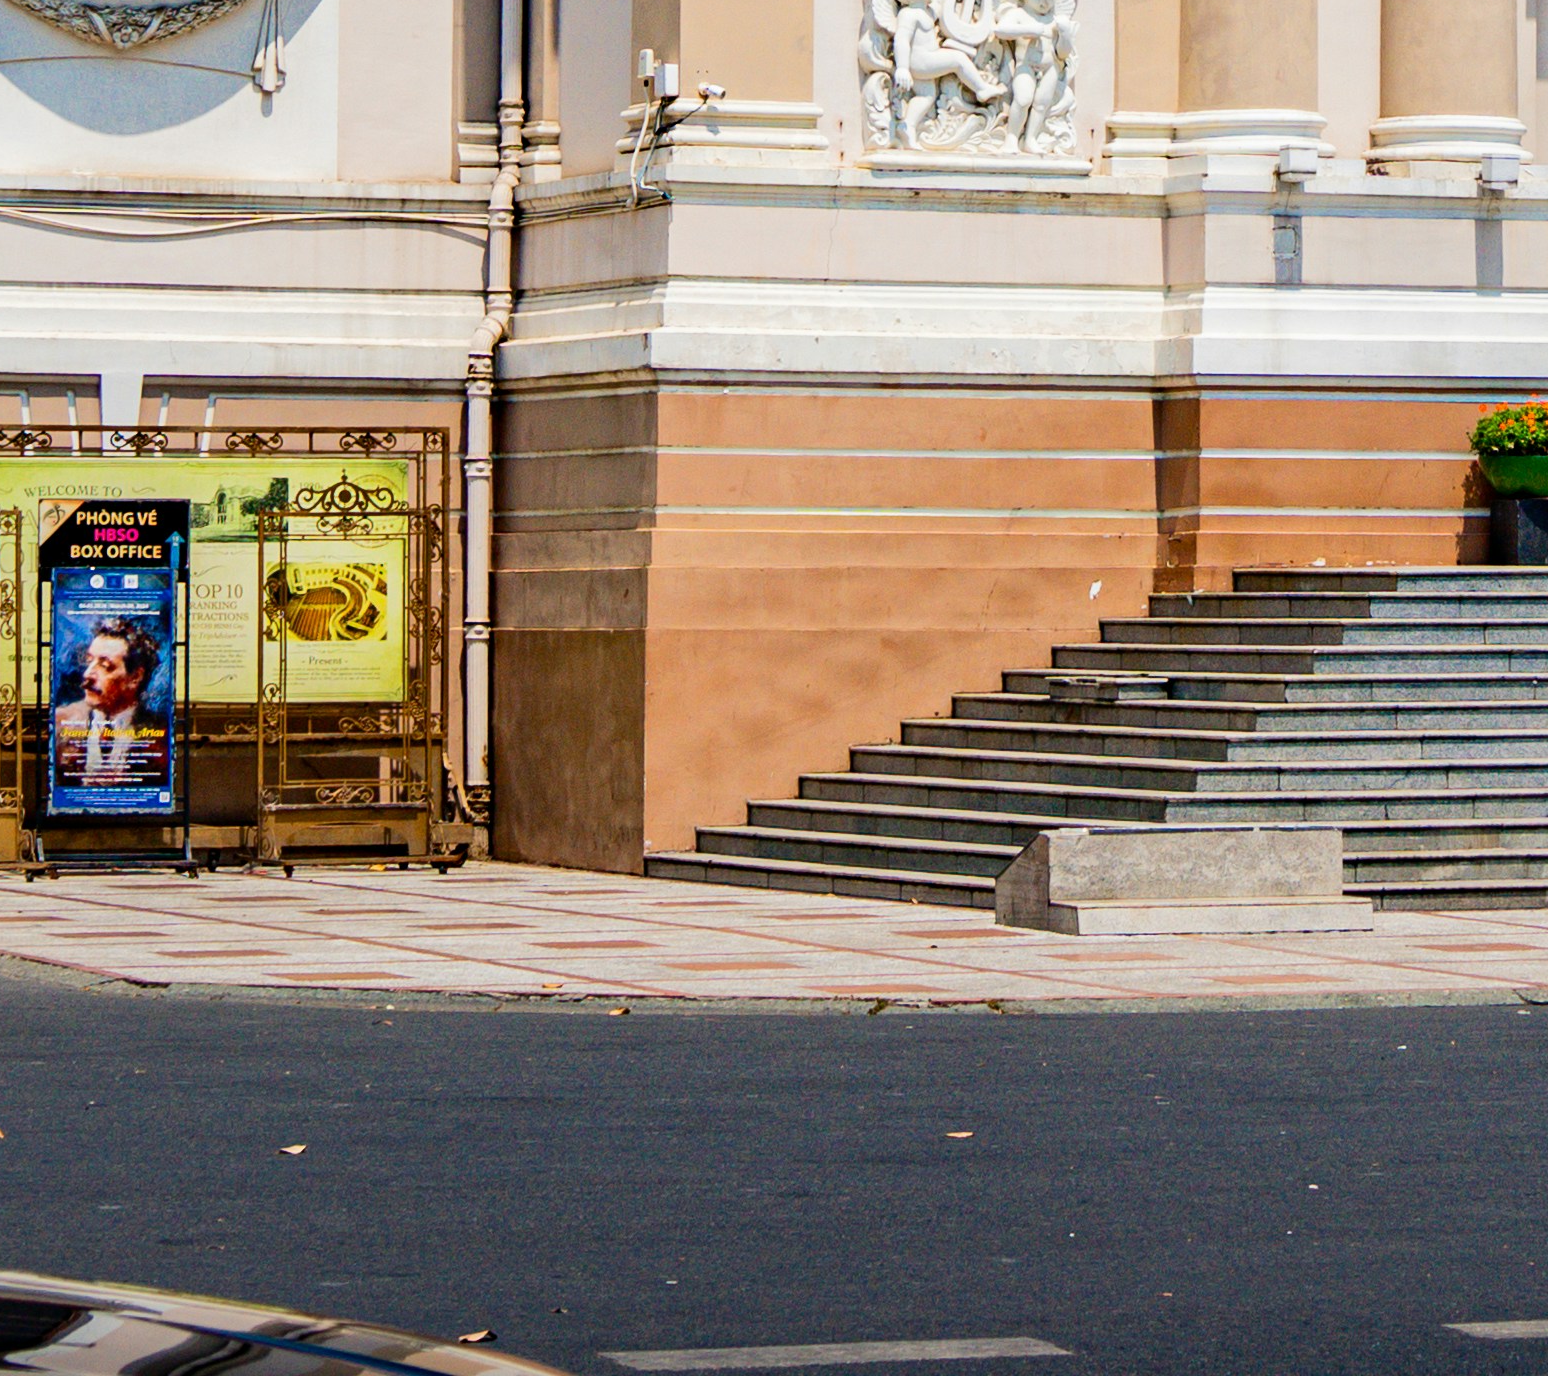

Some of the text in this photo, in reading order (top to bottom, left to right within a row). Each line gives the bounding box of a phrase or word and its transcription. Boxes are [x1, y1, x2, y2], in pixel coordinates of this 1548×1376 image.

[24, 484, 123, 498] WELCOME TO
[76, 508, 158, 526] PHÒNG VÉ
[93, 528, 139, 543] HBSO
[70, 544, 162, 559] BOX OFFICE
[227, 583, 243, 599] 10
[177, 612, 249, 622] ATRACTIONS
[308, 656, 342, 665] Present
